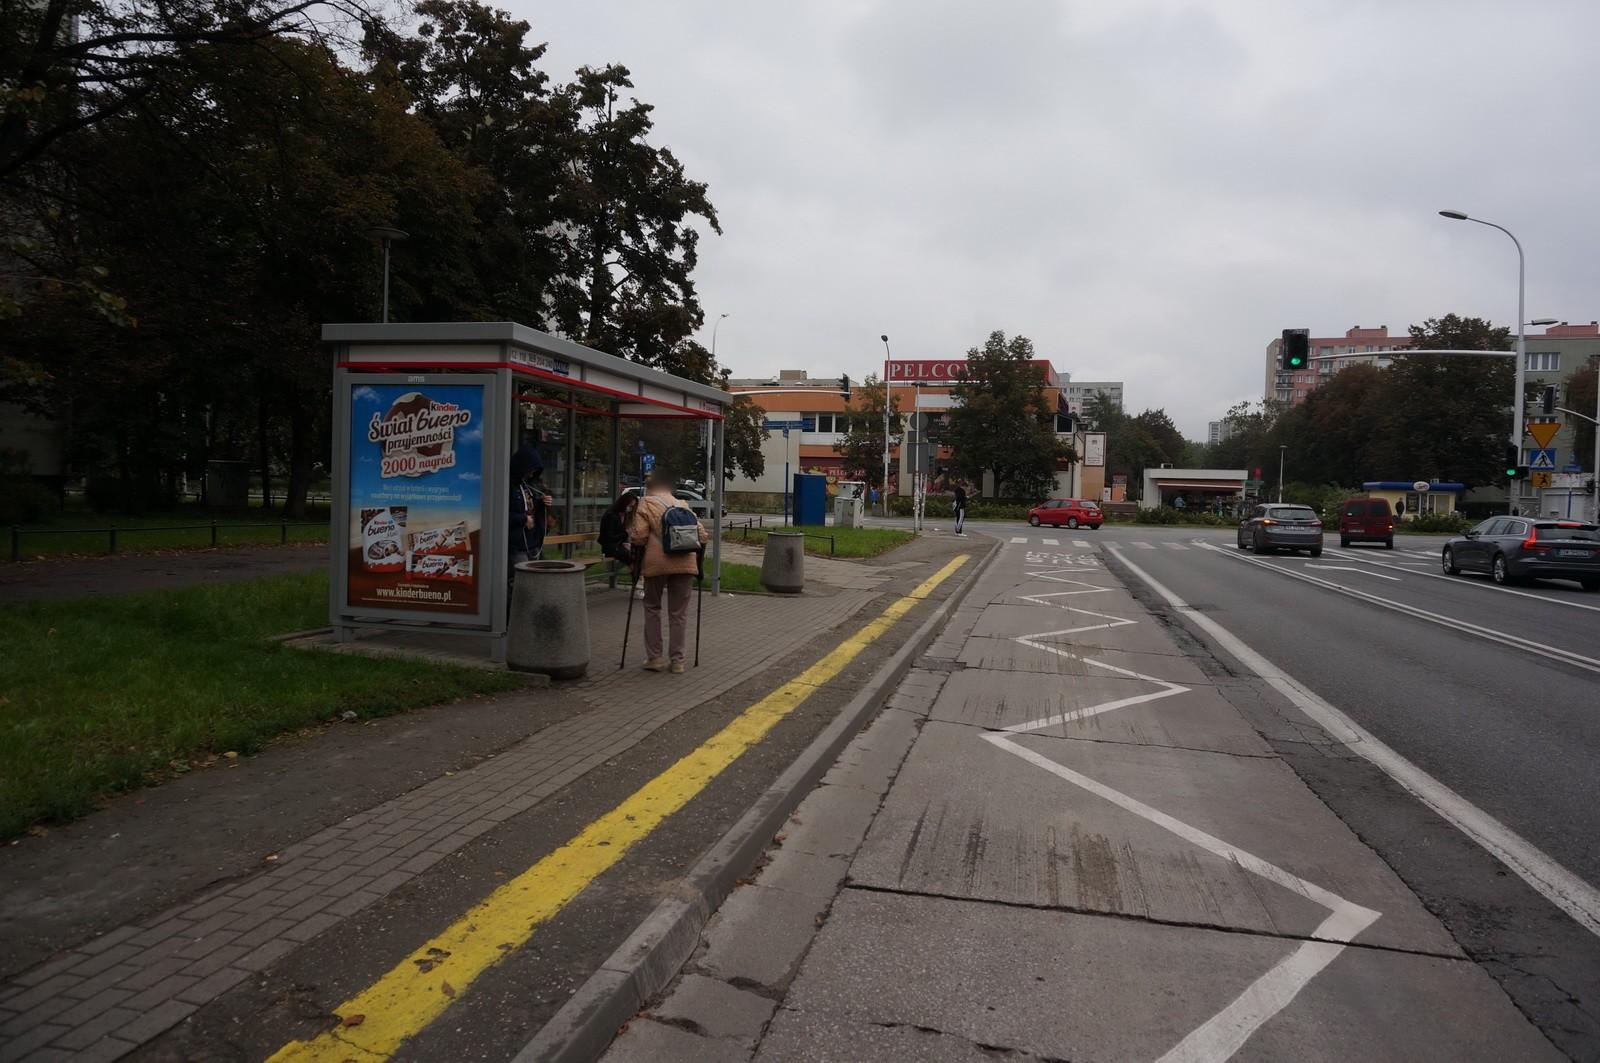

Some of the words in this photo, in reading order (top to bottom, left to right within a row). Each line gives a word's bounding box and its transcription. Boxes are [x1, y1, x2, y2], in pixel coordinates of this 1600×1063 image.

[370, 412, 414, 440] Świat
[416, 411, 469, 432] bueno
[388, 428, 452, 450] przyjemności
[383, 456, 416, 475] 2000
[419, 452, 453, 470] nagród
[368, 525, 395, 537] bueno
[376, 587, 453, 603] www.kinderbueno.pl
